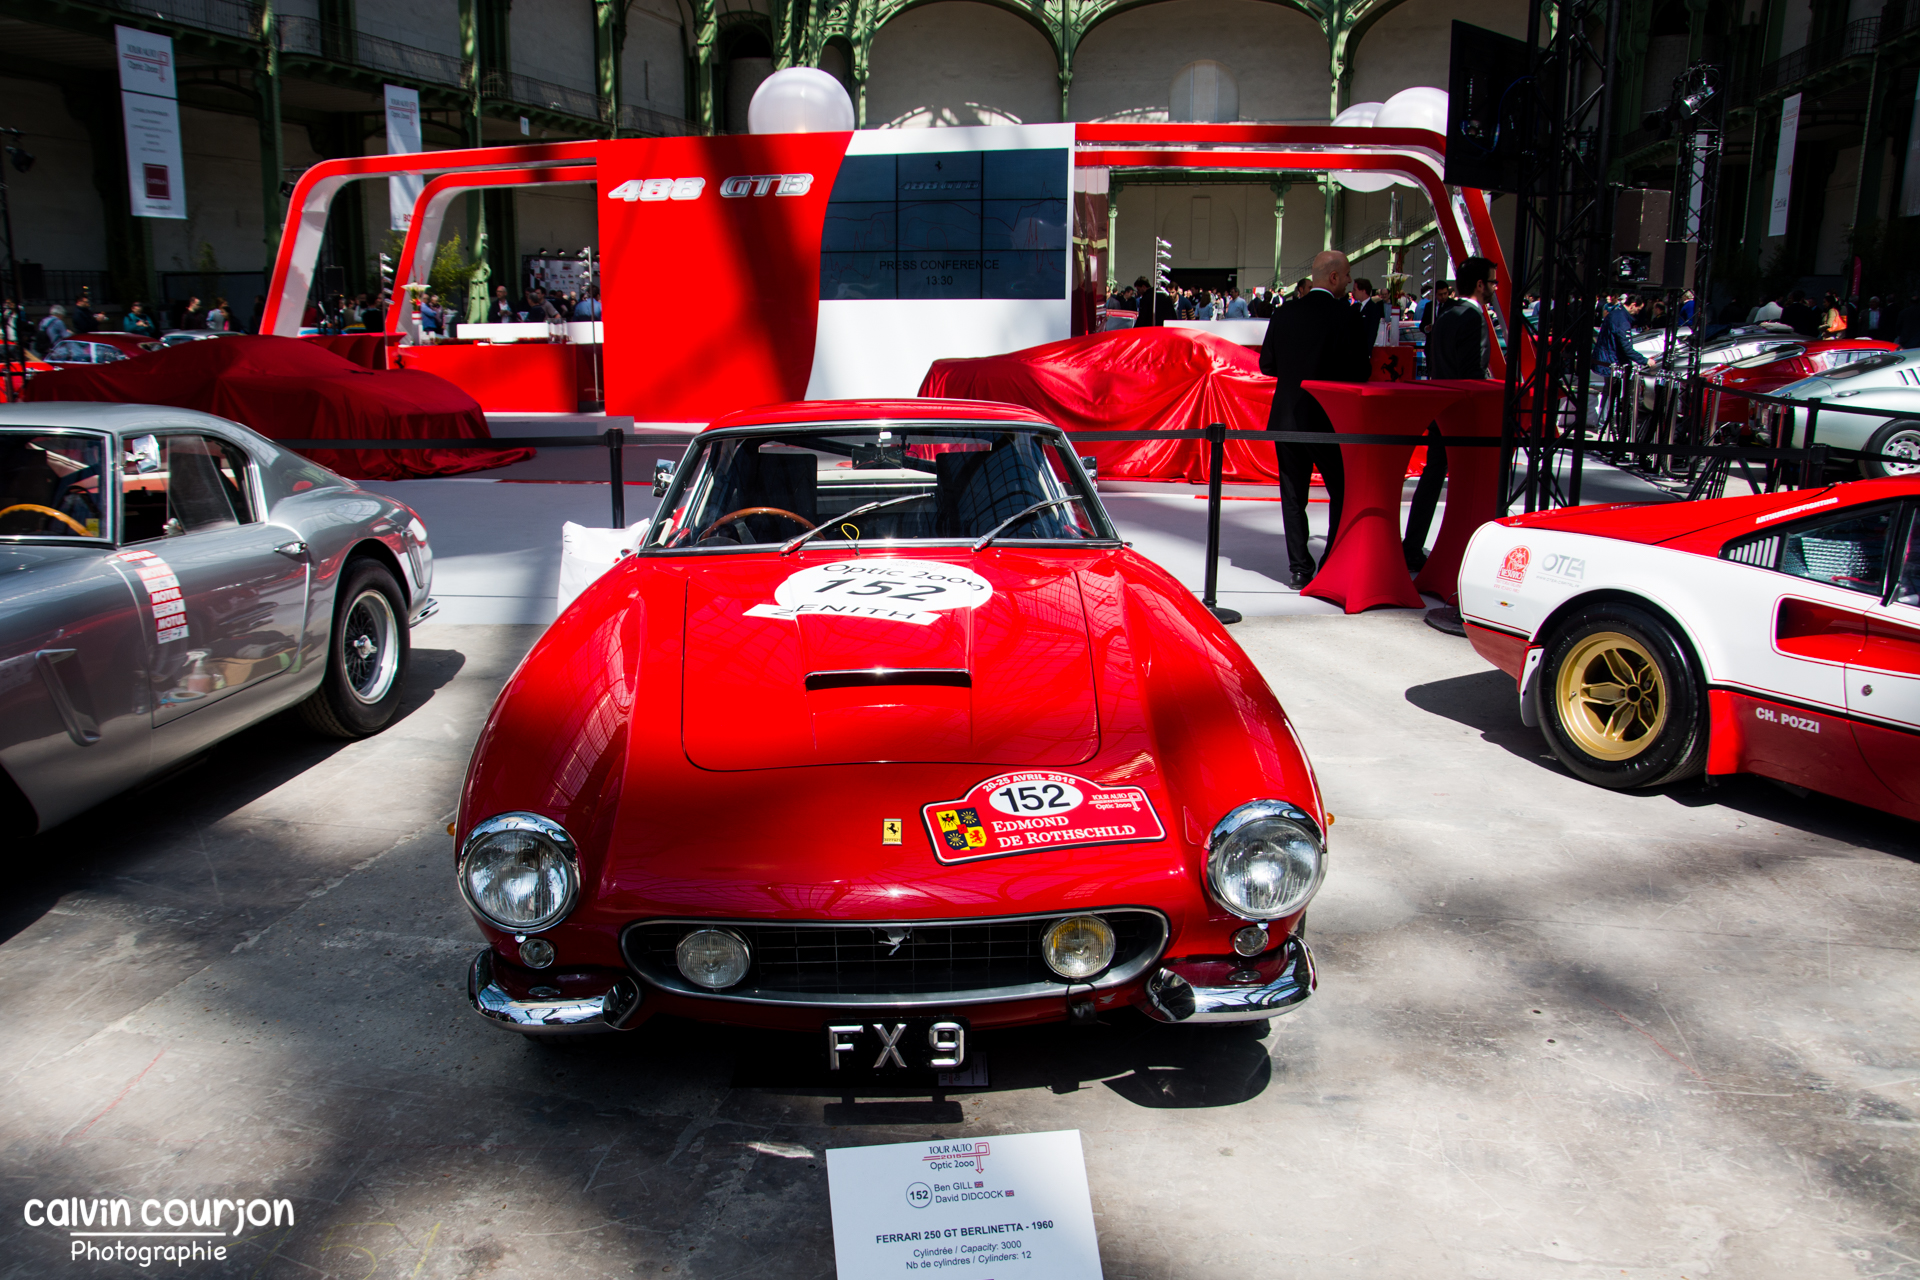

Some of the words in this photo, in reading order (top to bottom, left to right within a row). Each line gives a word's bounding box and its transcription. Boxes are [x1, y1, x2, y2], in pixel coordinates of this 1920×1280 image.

[608, 177, 705, 201] 488
[720, 173, 814, 198] GTB
[880, 260, 917, 270] PRESS
[920, 260, 999, 270] CONFERENCE
[926, 276, 953, 285] 13:30
[140, 565, 173, 580] MOTUL
[823, 564, 904, 575] Optic
[1542, 553, 1586, 579] OTEA
[152, 588, 182, 604] MOTUL
[814, 578, 947, 602] 152
[771, 604, 916, 619] ZENITH
[158, 613, 186, 630] MOTUL
[1756, 707, 1778, 723] CH.
[1781, 713, 1819, 733] POZZI
[982, 776, 1011, 792] 20-25
[1013, 774, 1045, 782] AVRIL
[1048, 774, 1076, 784] 2015
[999, 784, 1071, 812] 152
[991, 816, 1069, 833] EDMOND
[929, 1146, 950, 1155] TOUR
[951, 1143, 972, 1152] AUTO
[930, 1161, 952, 1171] Optic
[909, 1190, 929, 1200] 152
[934, 1184, 951, 1192] Ben
[953, 1182, 973, 1190] GILL
[935, 1194, 959, 1203] David
[961, 1190, 1004, 1201] DIDCOCK
[876, 1232, 922, 1244] FERRARI
[924, 1230, 941, 1240] 250
[944, 1228, 958, 1237] GT
[960, 1222, 1024, 1237] BERLINETTA
[1031, 1220, 1054, 1230] 1960
[913, 1247, 953, 1259] Cylindrée
[960, 1243, 999, 1254] Capacity:
[1001, 1240, 1021, 1249] 3000
[906, 1261, 918, 1269] Nb
[920, 1260, 931, 1268] de
[933, 1256, 971, 1269] cylindres
[978, 1252, 1019, 1264] Cylinders:
[1021, 1250, 1032, 1259] 12
